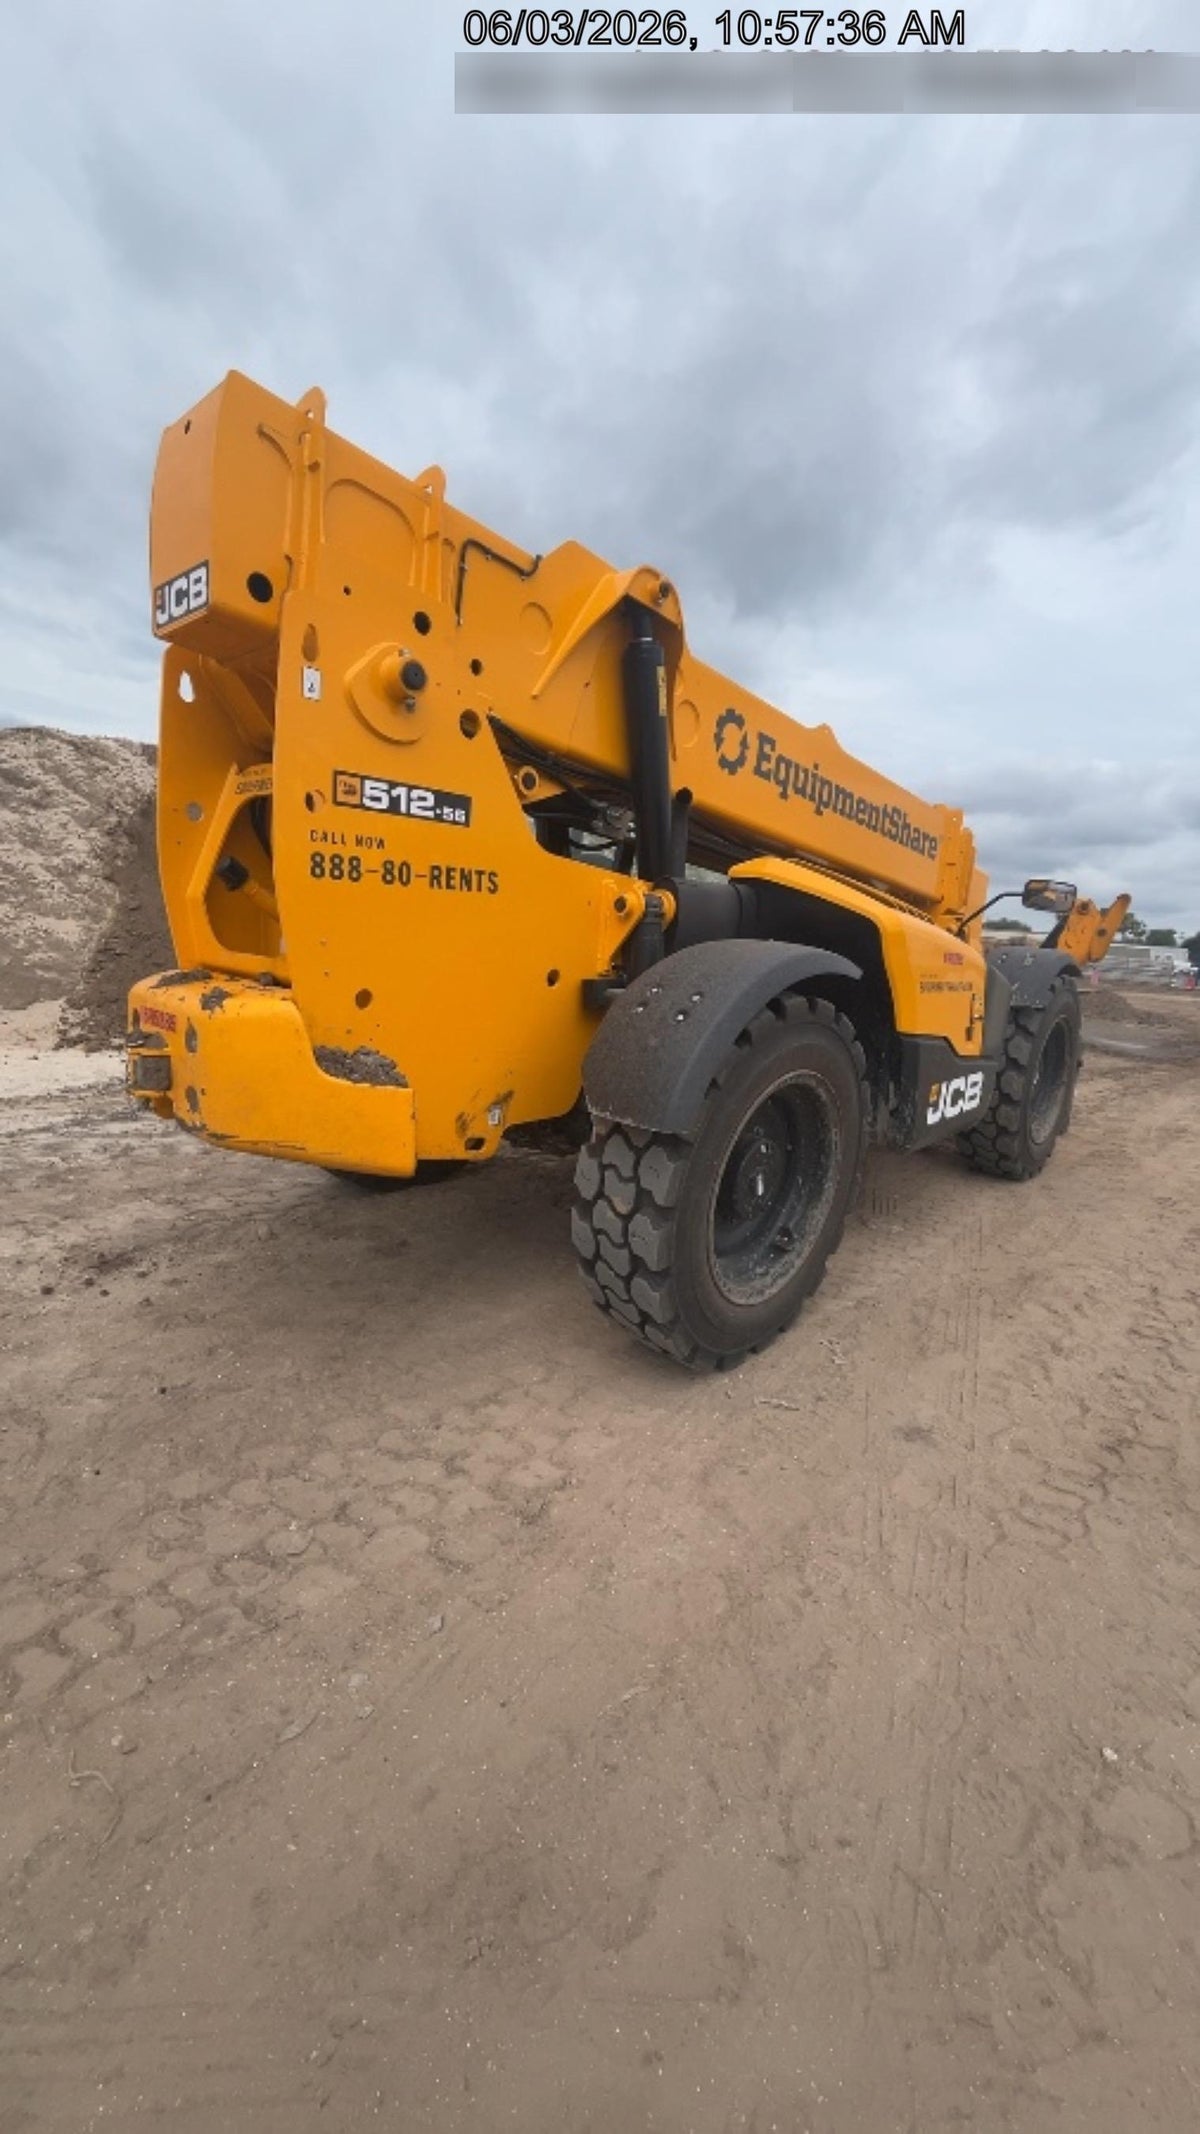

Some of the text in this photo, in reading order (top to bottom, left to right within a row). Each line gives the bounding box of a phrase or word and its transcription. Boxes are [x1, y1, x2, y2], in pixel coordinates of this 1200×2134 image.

[155, 565, 208, 625] JCB
[753, 731, 939, 860] EquipmentShare
[310, 829, 386, 850] CALL NOW
[310, 851, 500, 895] 888-80-RENTS
[926, 1070, 984, 1125] JCB
